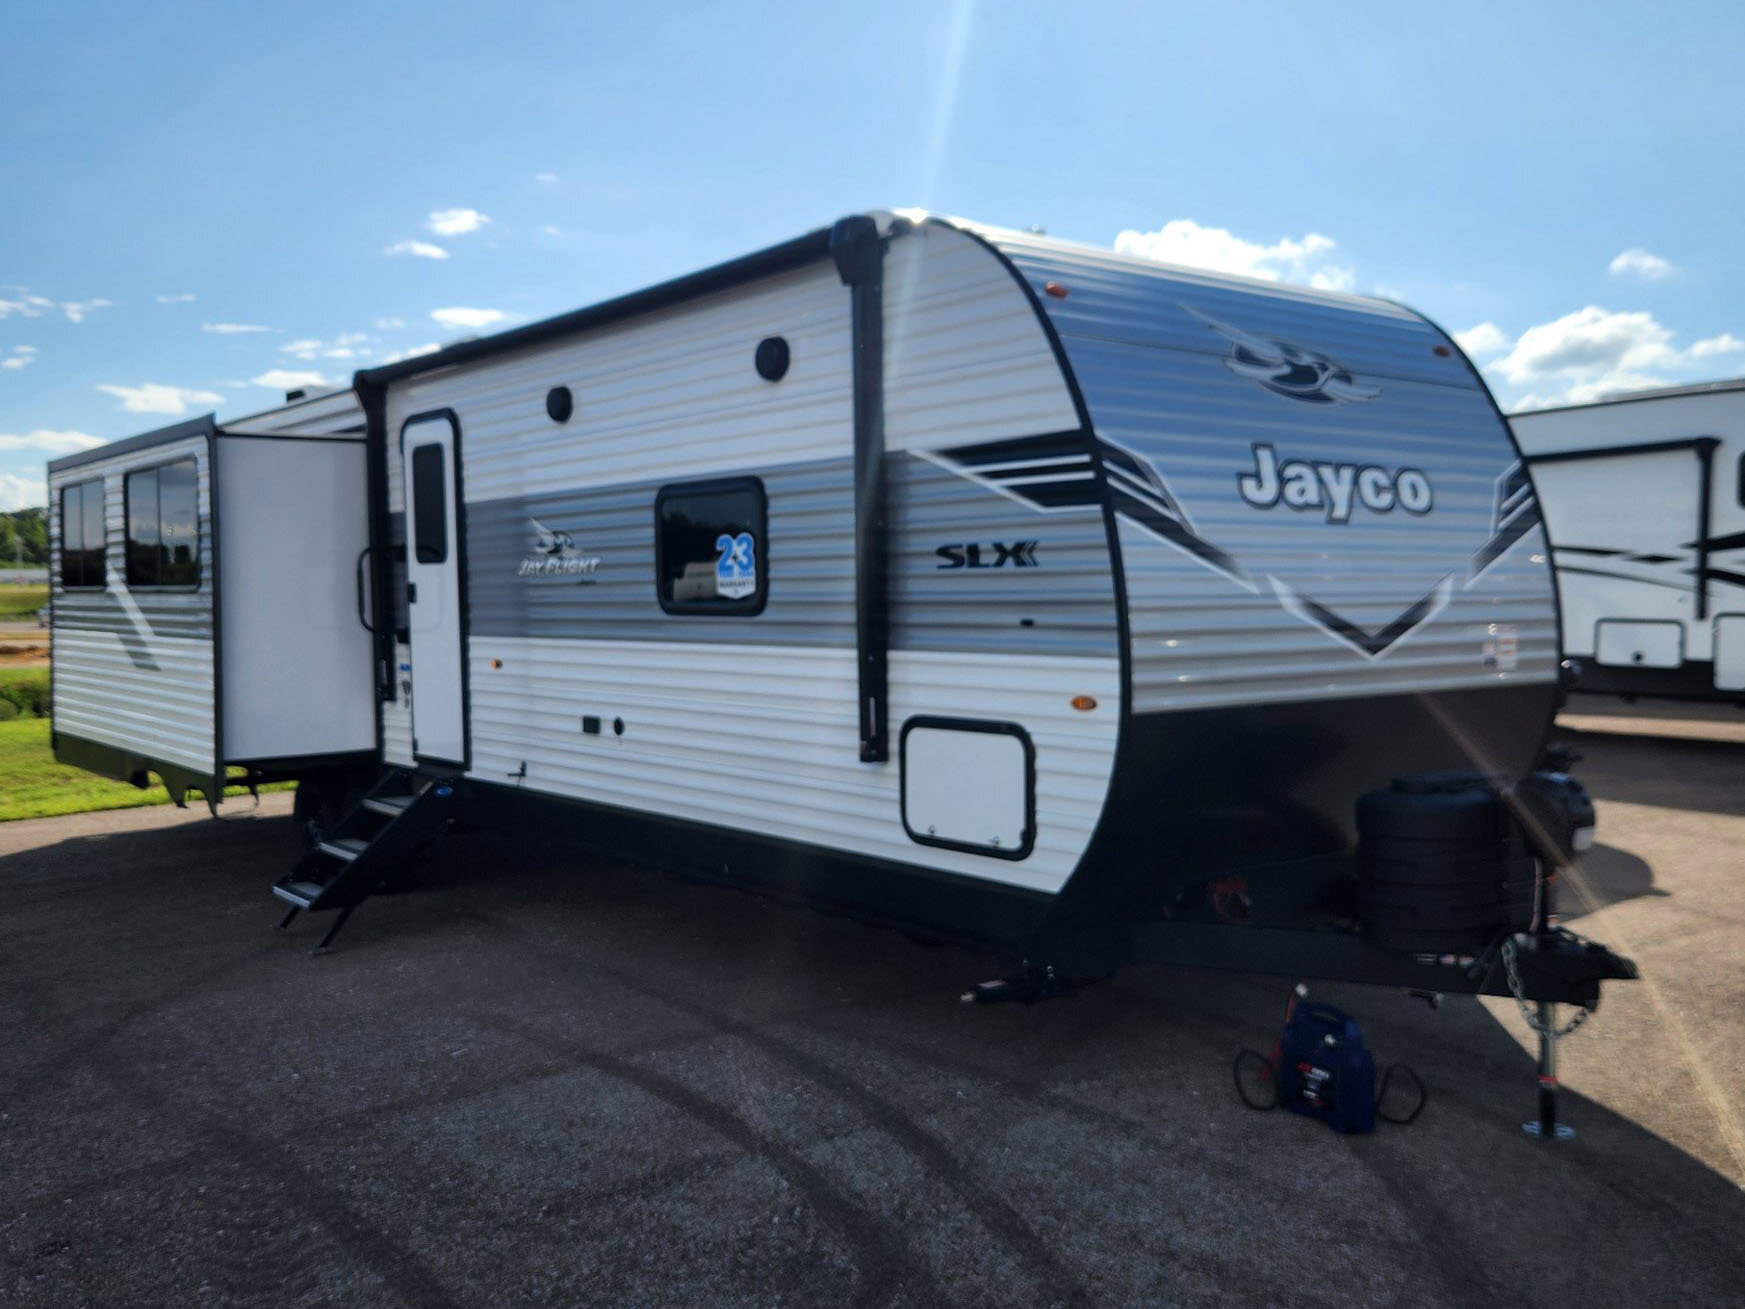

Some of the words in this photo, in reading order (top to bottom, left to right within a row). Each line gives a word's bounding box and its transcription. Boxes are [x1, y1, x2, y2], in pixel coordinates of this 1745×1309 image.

[1236, 442, 1433, 525] Jayco
[517, 559, 545, 576] JAY
[545, 557, 601, 575] FLIGHT
